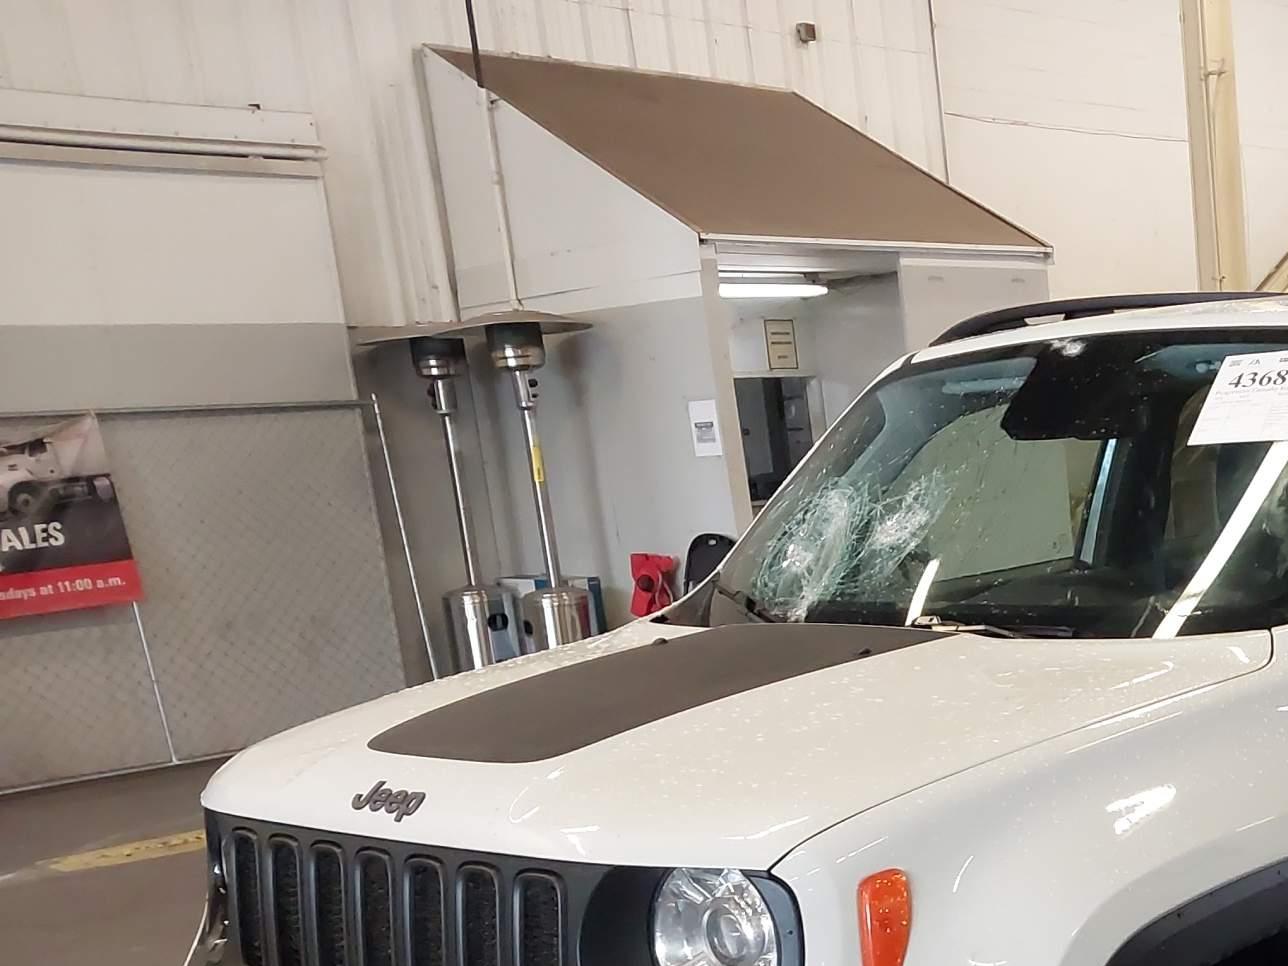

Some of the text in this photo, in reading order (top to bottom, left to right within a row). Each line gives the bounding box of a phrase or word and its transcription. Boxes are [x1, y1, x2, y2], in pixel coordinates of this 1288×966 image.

[0, 521, 65, 552] ALES
[40, 584, 54, 596] at
[57, 577, 94, 593] 11:00
[96, 576, 126, 589] a.m.
[351, 780, 426, 823] Jeep
